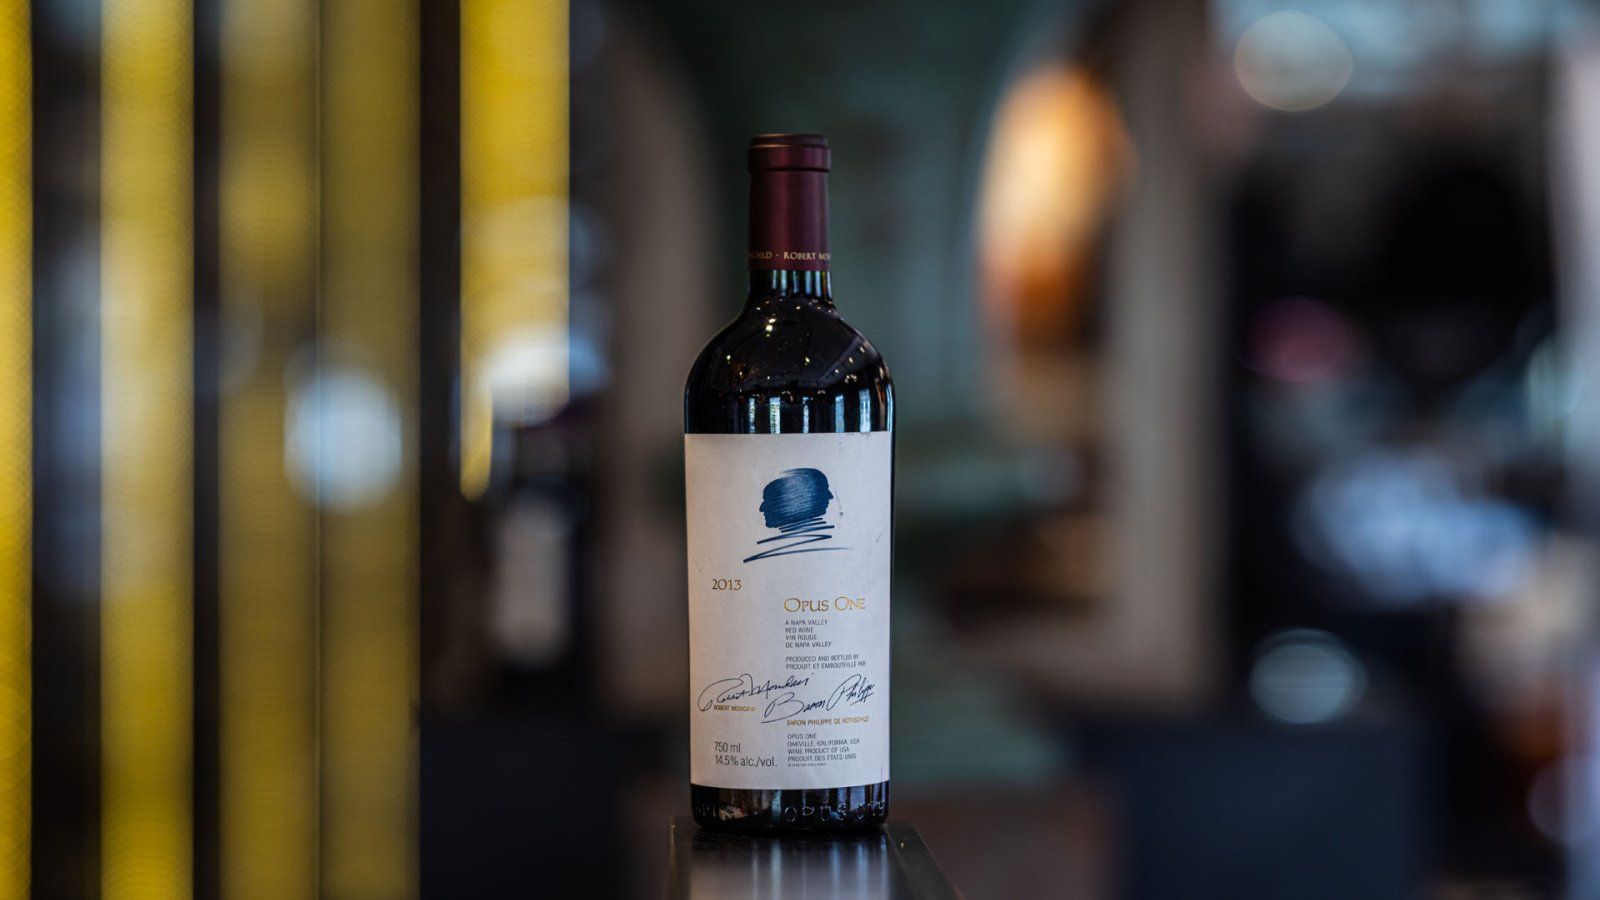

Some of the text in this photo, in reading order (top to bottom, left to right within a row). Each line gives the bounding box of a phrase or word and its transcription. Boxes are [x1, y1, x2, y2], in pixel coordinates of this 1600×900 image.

[784, 251, 816, 260] ROBERT
[712, 578, 742, 591] 2013
[784, 596, 866, 612] OPUS ONE
[714, 741, 741, 753] 750 ml
[715, 755, 739, 766] 14.5%
[740, 755, 778, 768] alc./vol.
